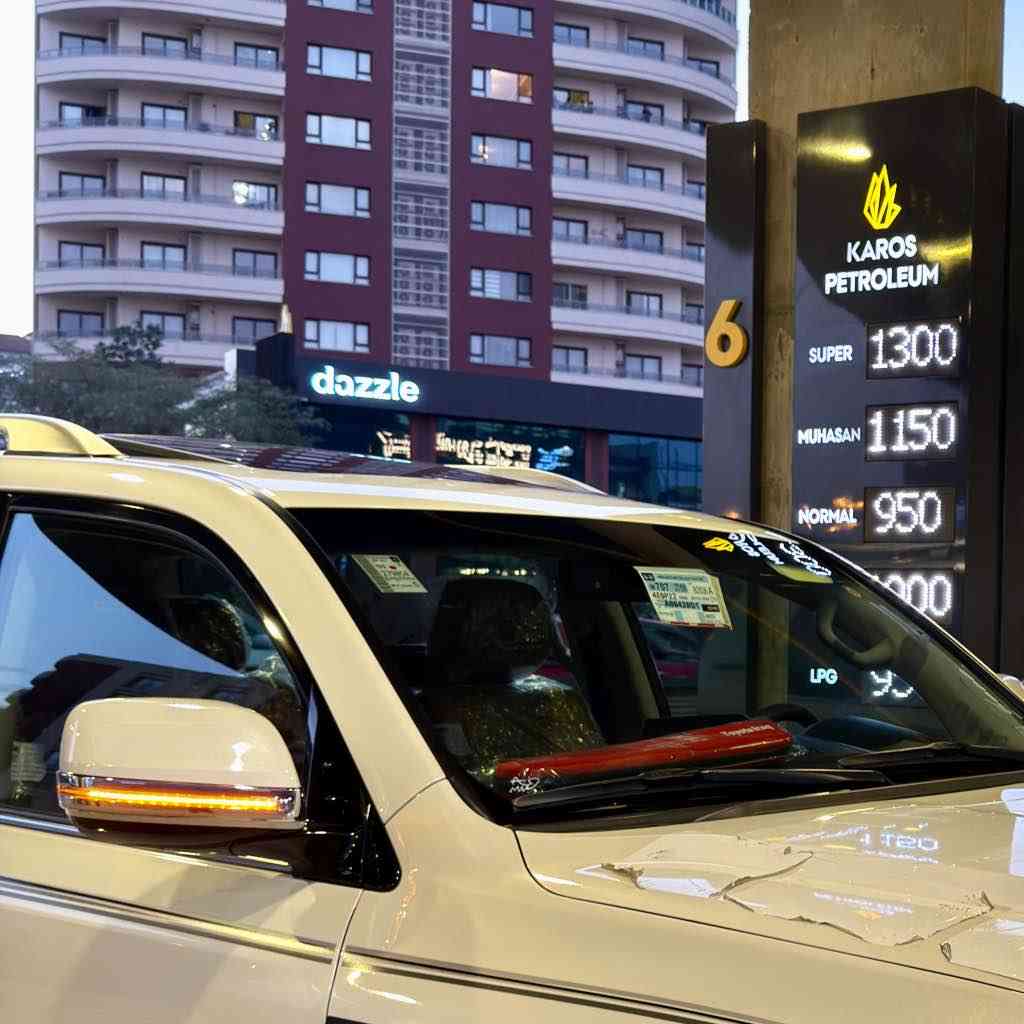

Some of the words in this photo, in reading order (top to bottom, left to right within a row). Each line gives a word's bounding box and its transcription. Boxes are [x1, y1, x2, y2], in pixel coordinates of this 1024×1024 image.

[846, 234, 918, 263] KAROS
[824, 264, 940, 295] PETROLEUM
[705, 299, 748, 368] 6
[808, 345, 853, 364] SUPER
[870, 323, 958, 370] 1300
[310, 365, 420, 403] dazzle
[797, 427, 861, 445] MUHASAN
[868, 408, 956, 453] 1150
[798, 508, 857, 525] NORMAL
[873, 491, 942, 534] 950
[810, 668, 838, 684] LPG
